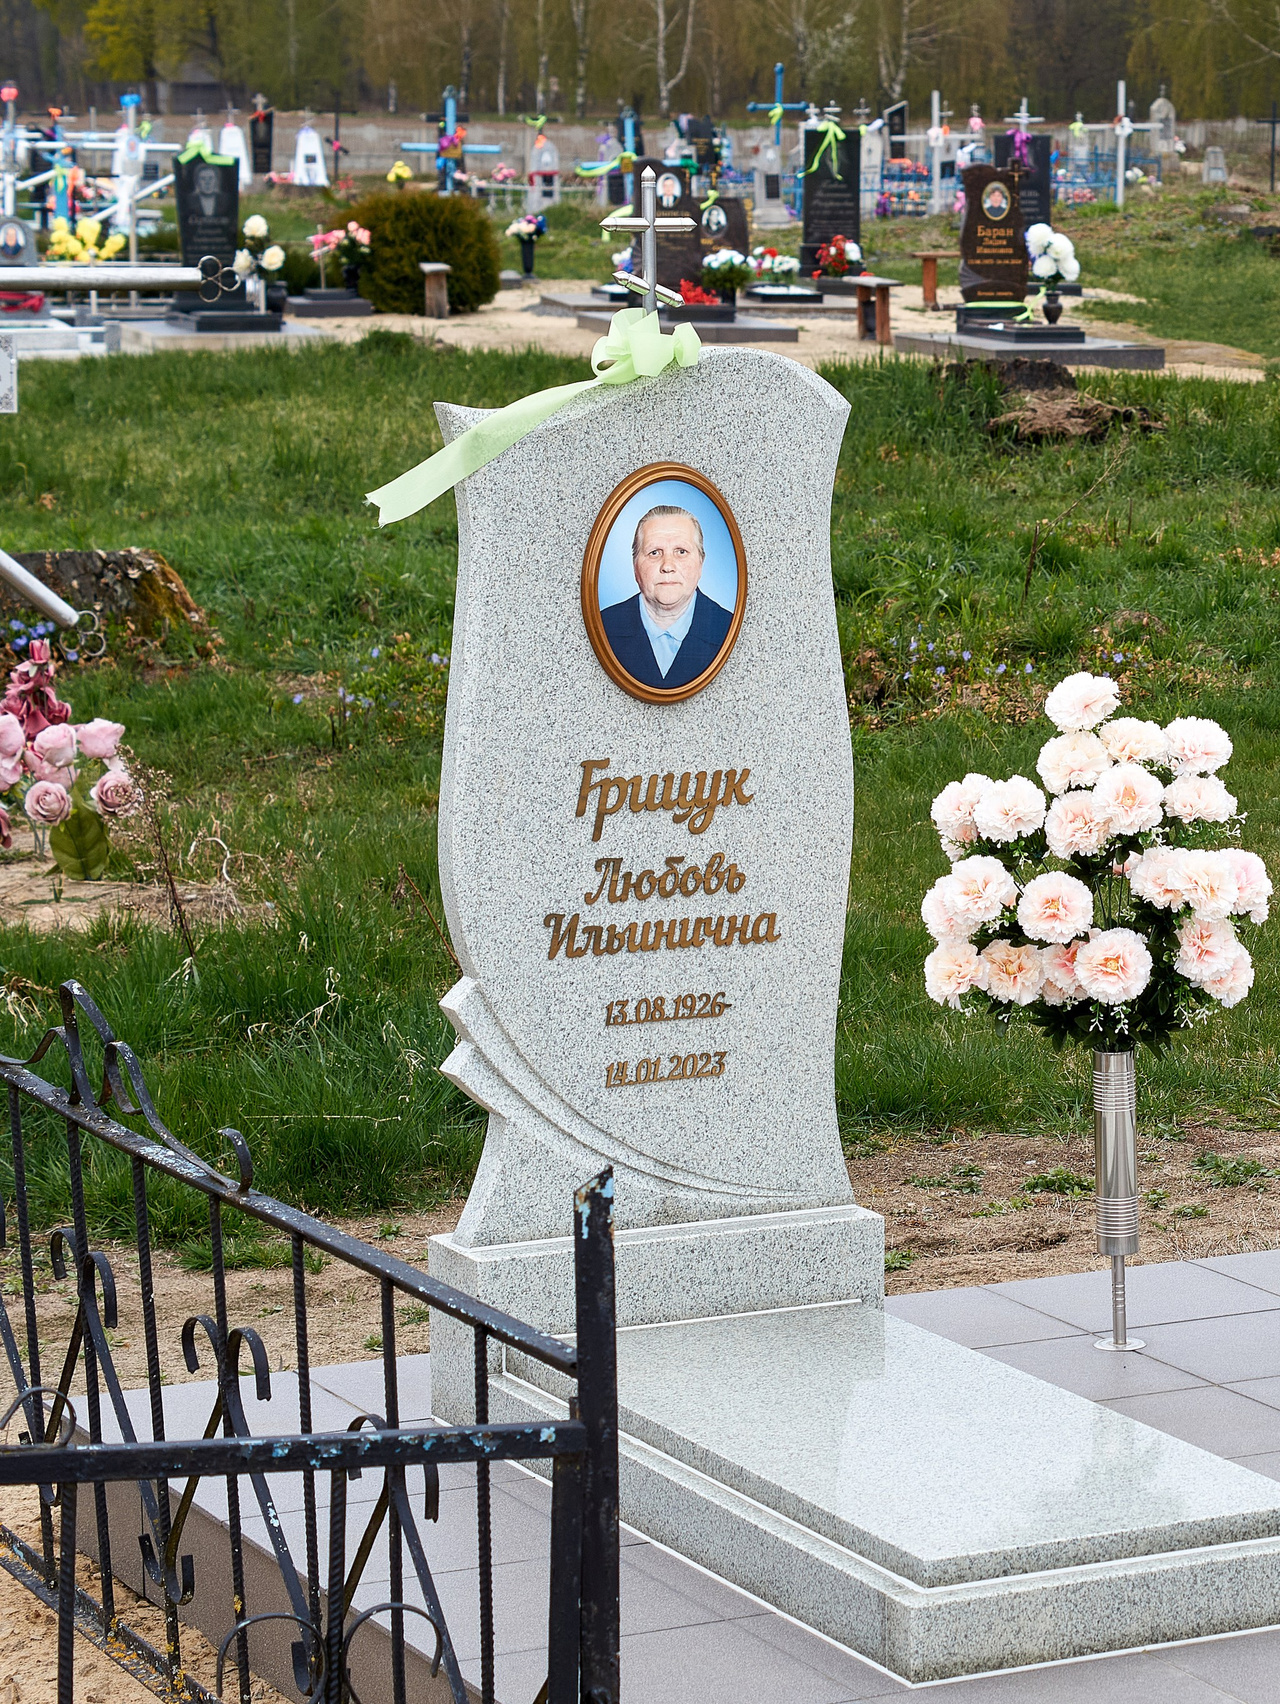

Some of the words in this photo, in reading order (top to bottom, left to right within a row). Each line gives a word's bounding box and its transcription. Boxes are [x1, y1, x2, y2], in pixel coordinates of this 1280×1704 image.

[977, 225, 1014, 239] Баран
[575, 758, 754, 842] Грищук
[584, 852, 747, 905] Любовь
[543, 912, 782, 961] Ильинична
[605, 1051, 729, 1088] 14.01.2023
